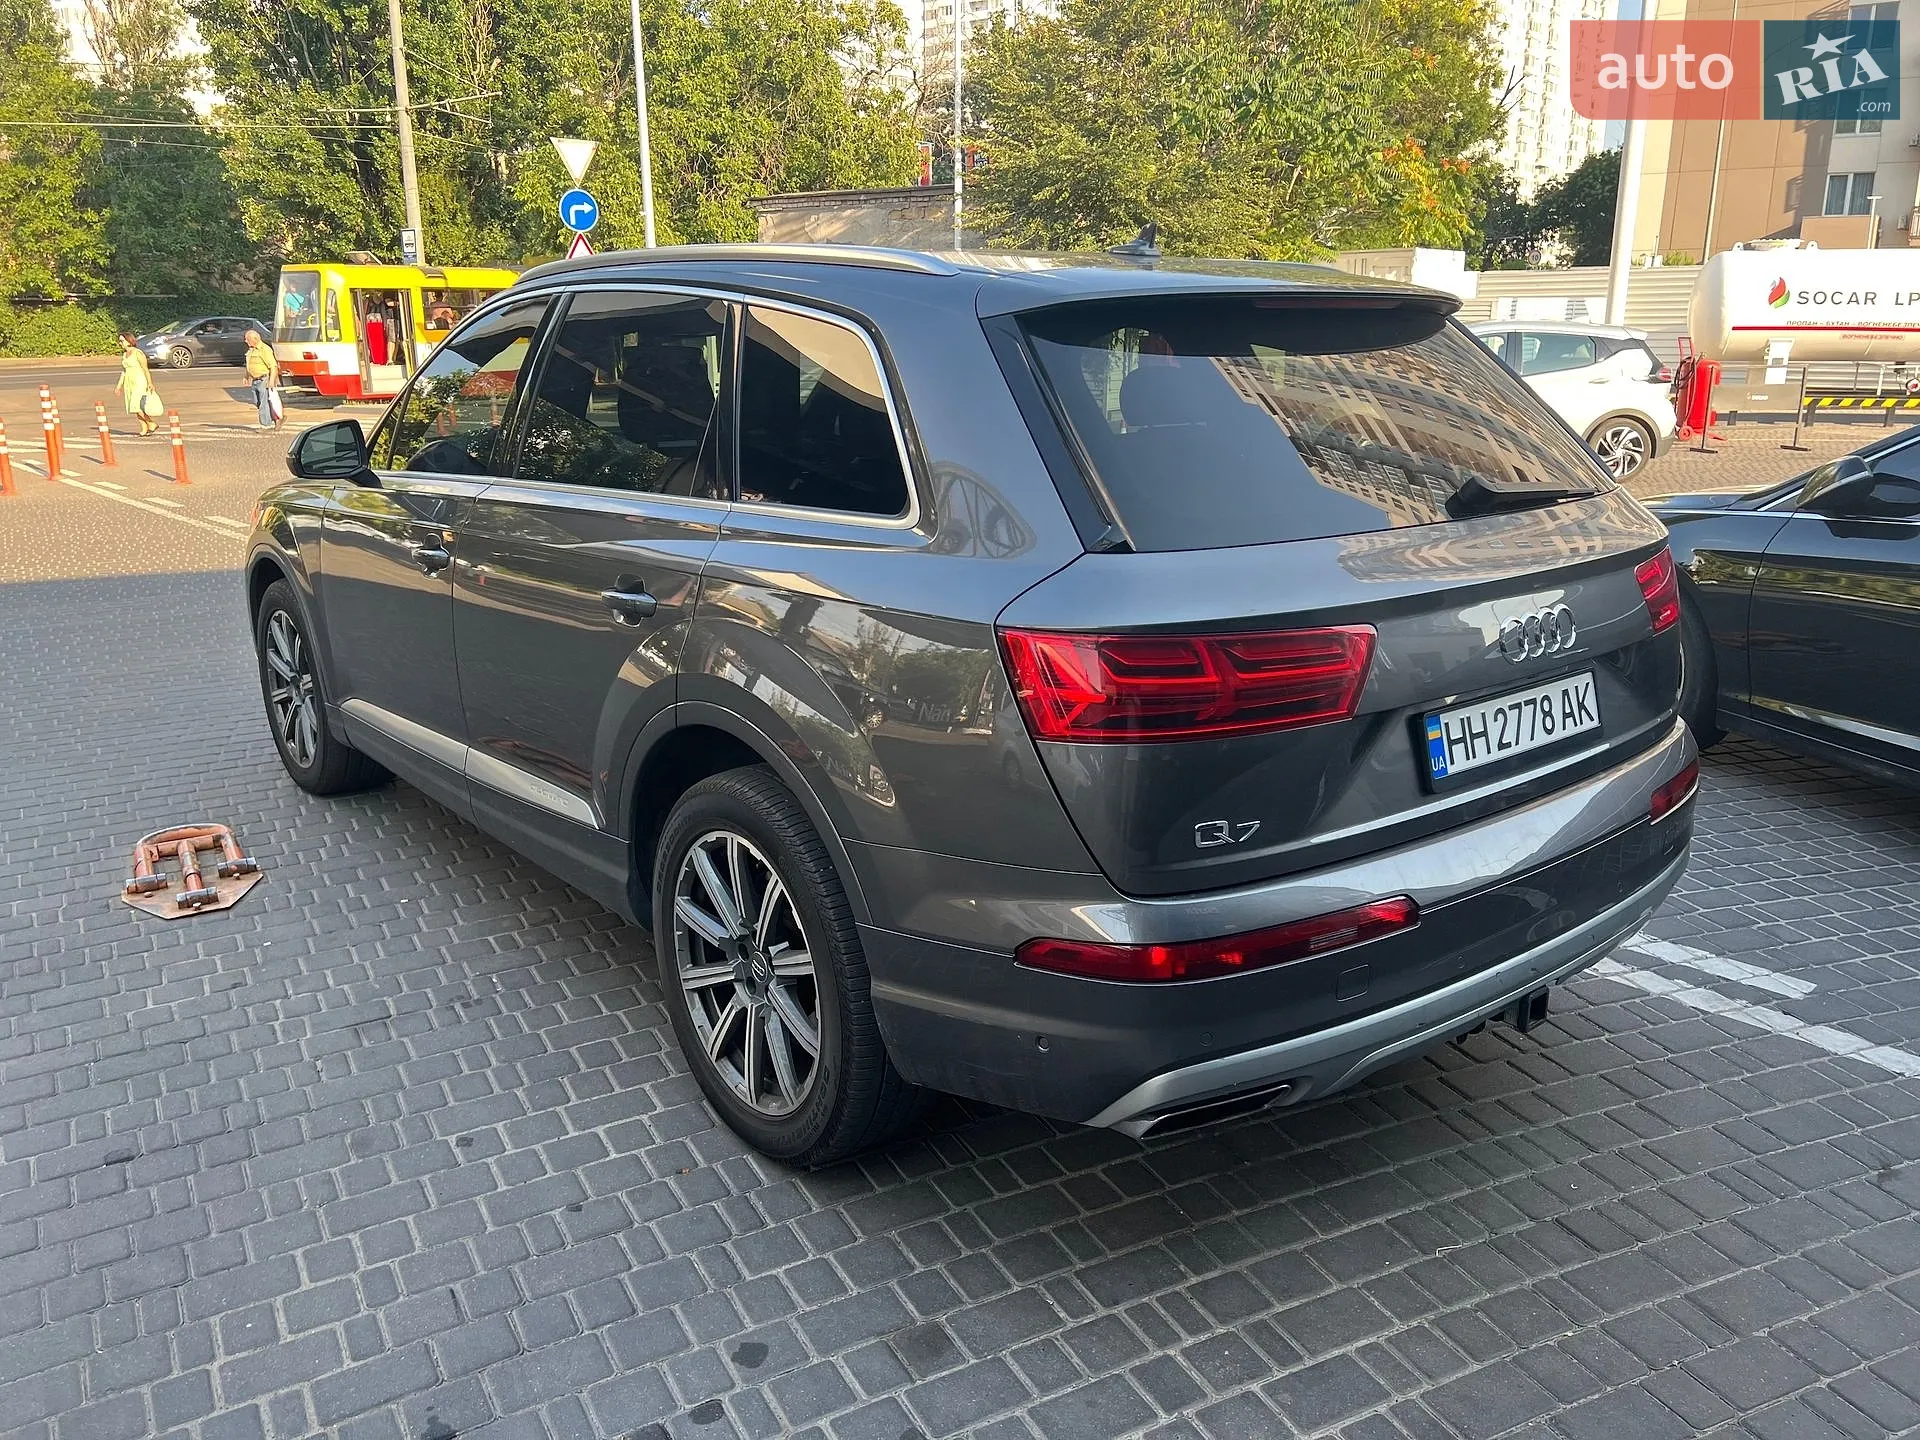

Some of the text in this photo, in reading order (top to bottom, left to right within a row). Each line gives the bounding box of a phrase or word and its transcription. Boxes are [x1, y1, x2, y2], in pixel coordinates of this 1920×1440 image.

[1796, 290, 1878, 306] SOCAR
[1444, 681, 1595, 766] HH 2778 AK
[1431, 757, 1447, 772] UA
[1195, 820, 1261, 849] Q7
